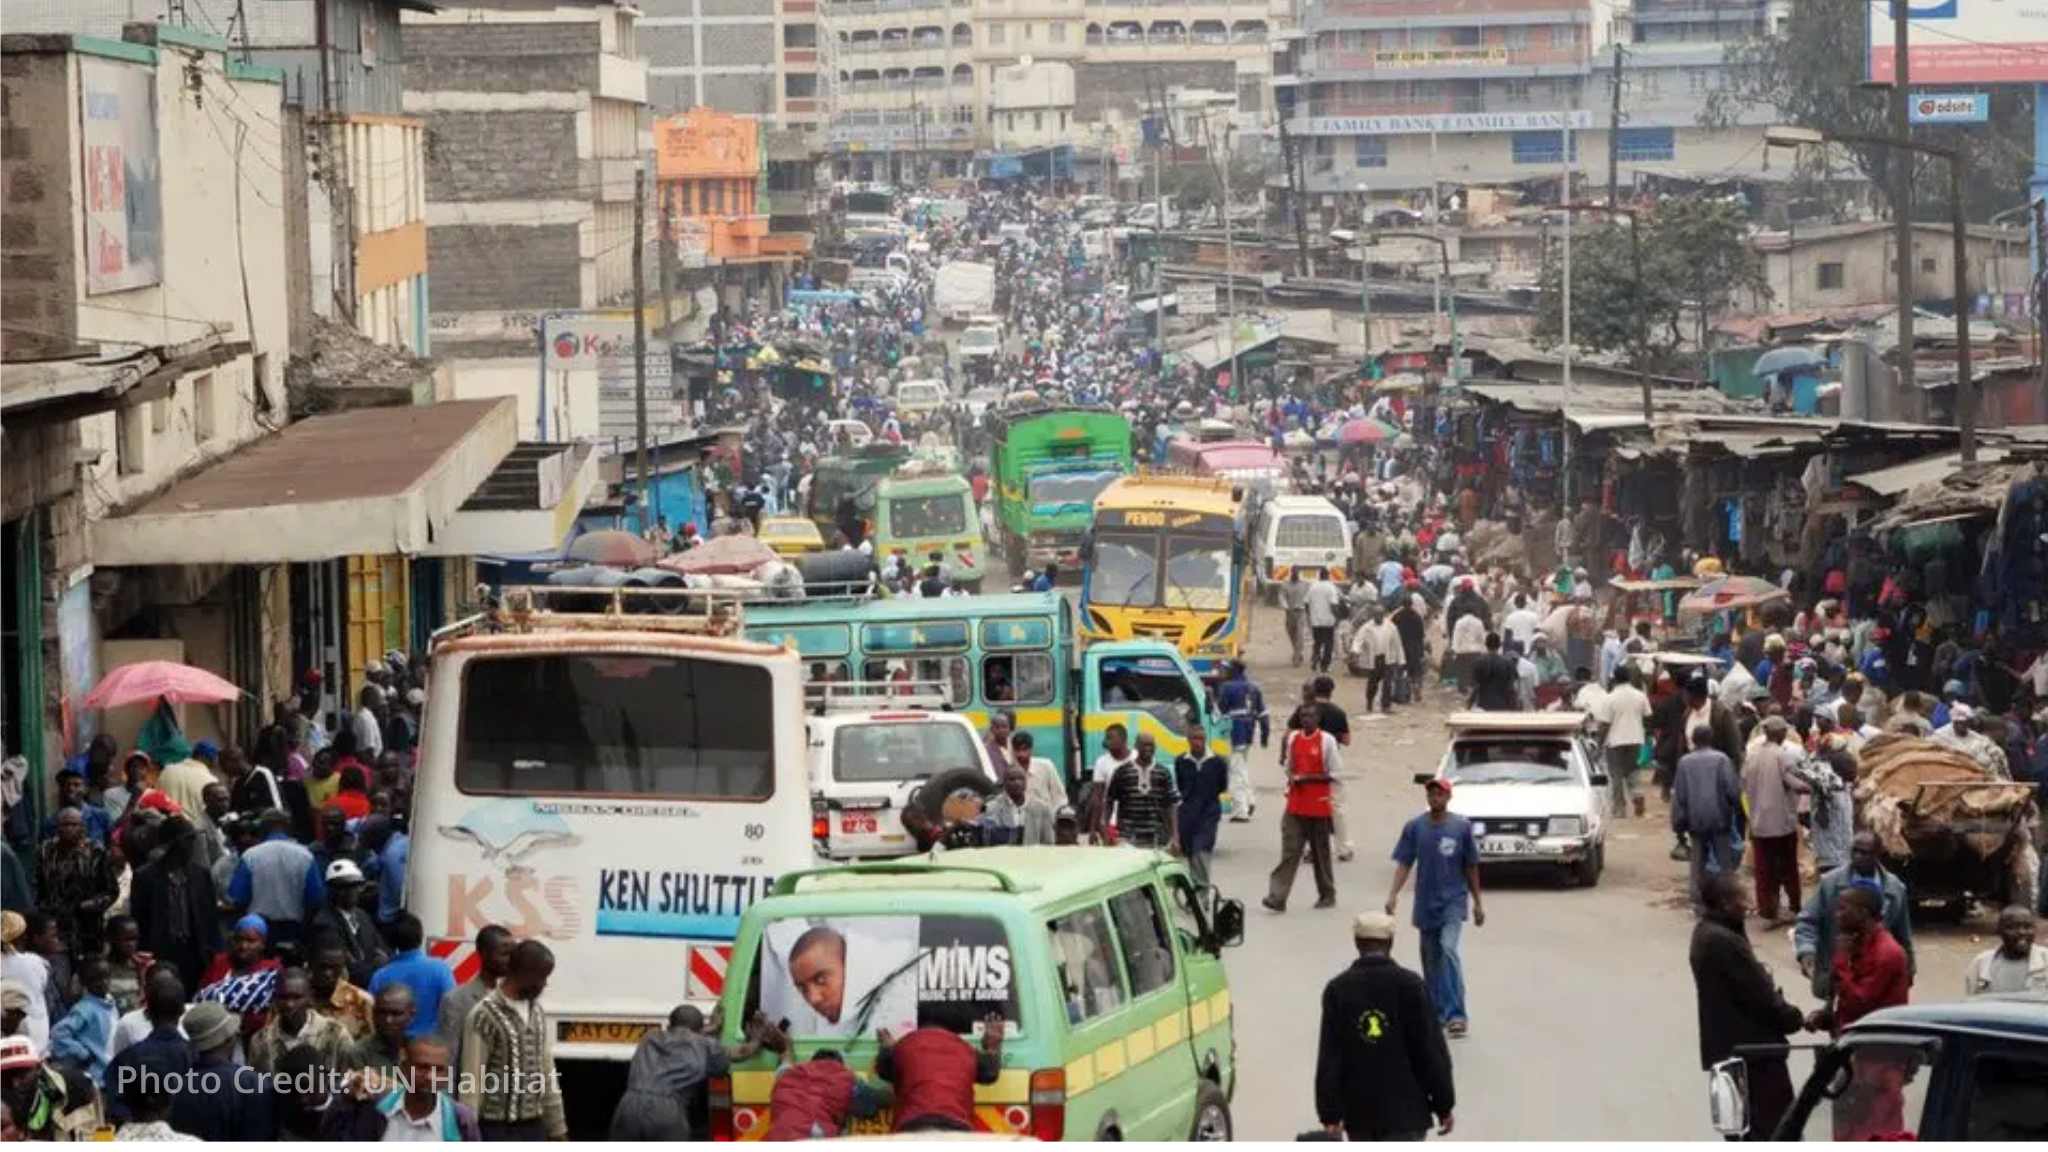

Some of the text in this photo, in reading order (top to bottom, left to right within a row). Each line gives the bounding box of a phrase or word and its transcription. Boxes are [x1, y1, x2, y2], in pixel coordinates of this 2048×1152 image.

[1937, 98, 1974, 113] adsite
[1324, 112, 1573, 132] FAMILY BANK FAMILY BANK
[743, 822, 765, 840] 80
[446, 868, 581, 942] KSS
[598, 868, 650, 911] KEN
[918, 938, 1010, 989] MIMS
